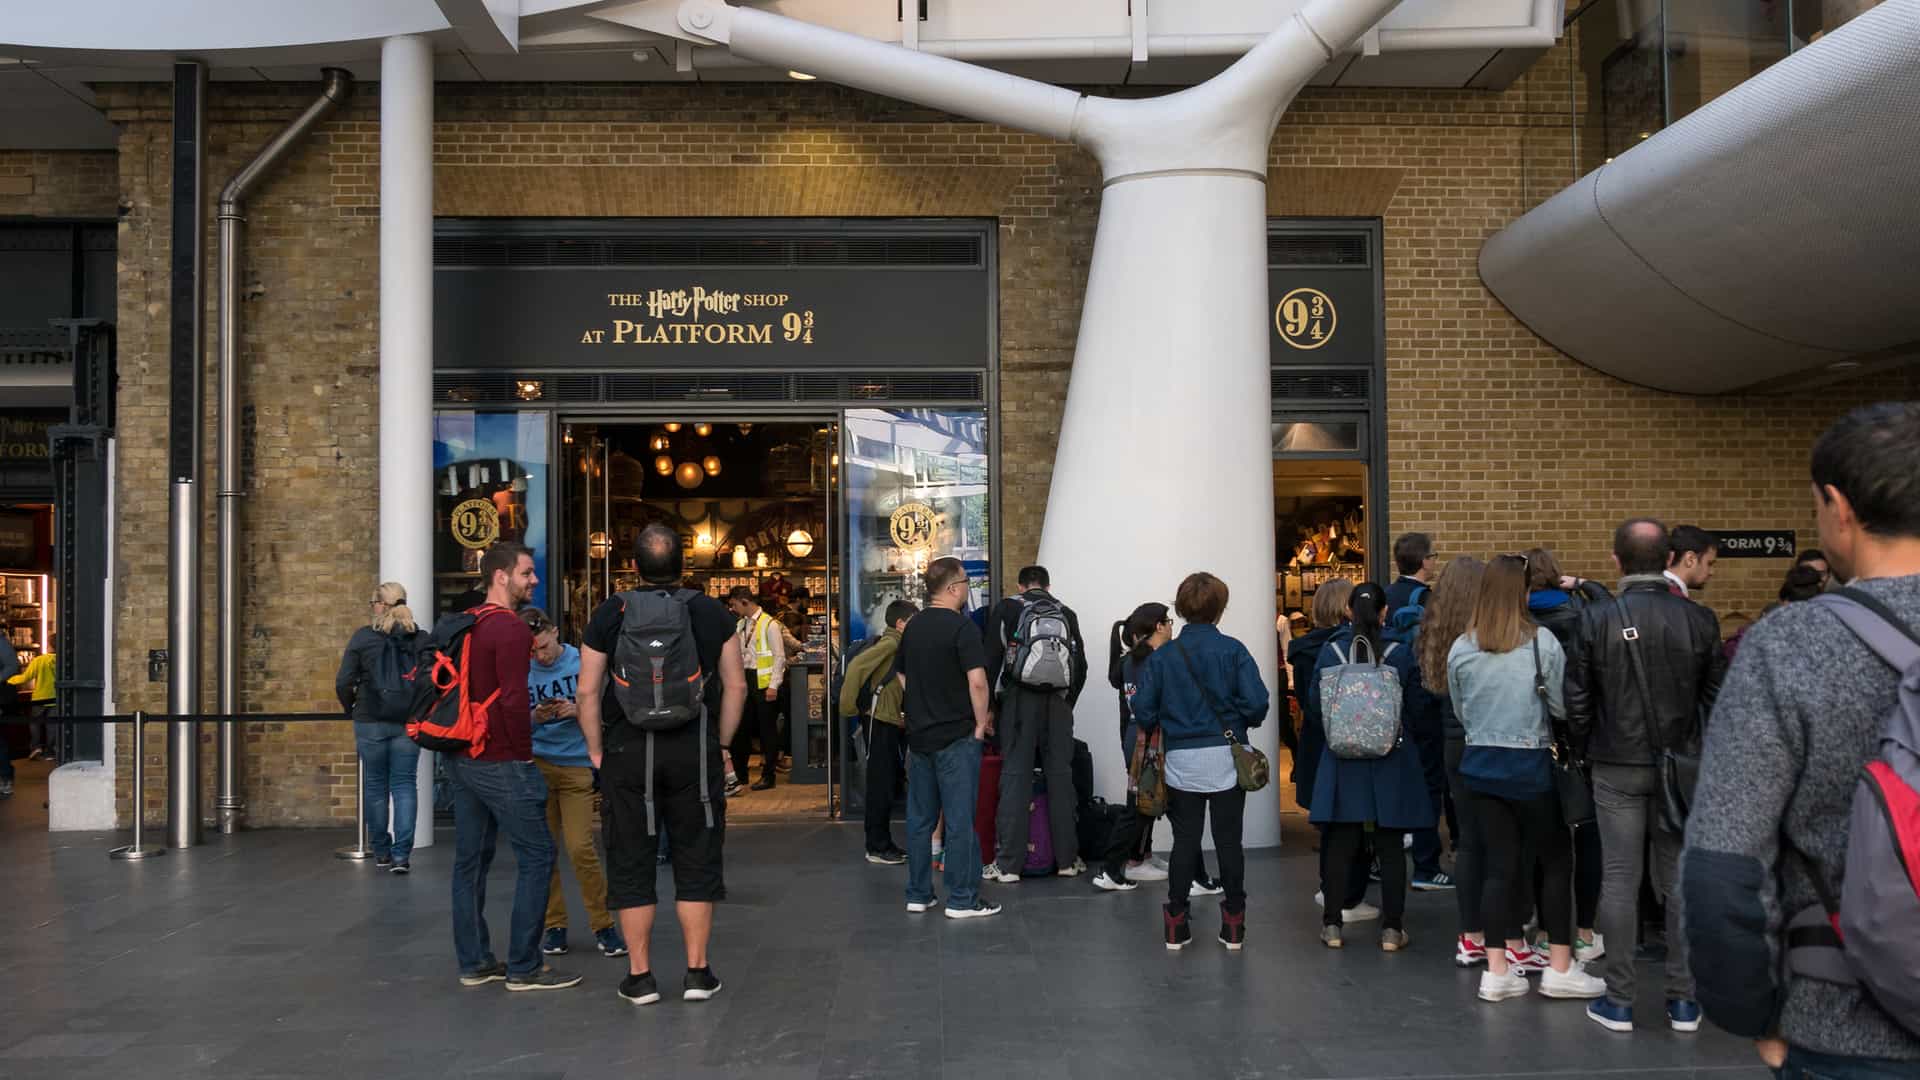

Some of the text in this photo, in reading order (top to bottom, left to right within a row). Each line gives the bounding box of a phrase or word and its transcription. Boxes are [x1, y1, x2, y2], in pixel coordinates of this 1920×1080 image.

[608, 286, 789, 323] THE Harry Potter SHOP
[581, 330, 605, 343] AT
[612, 320, 773, 344] PLATFORM
[528, 674, 579, 704] SKAT
